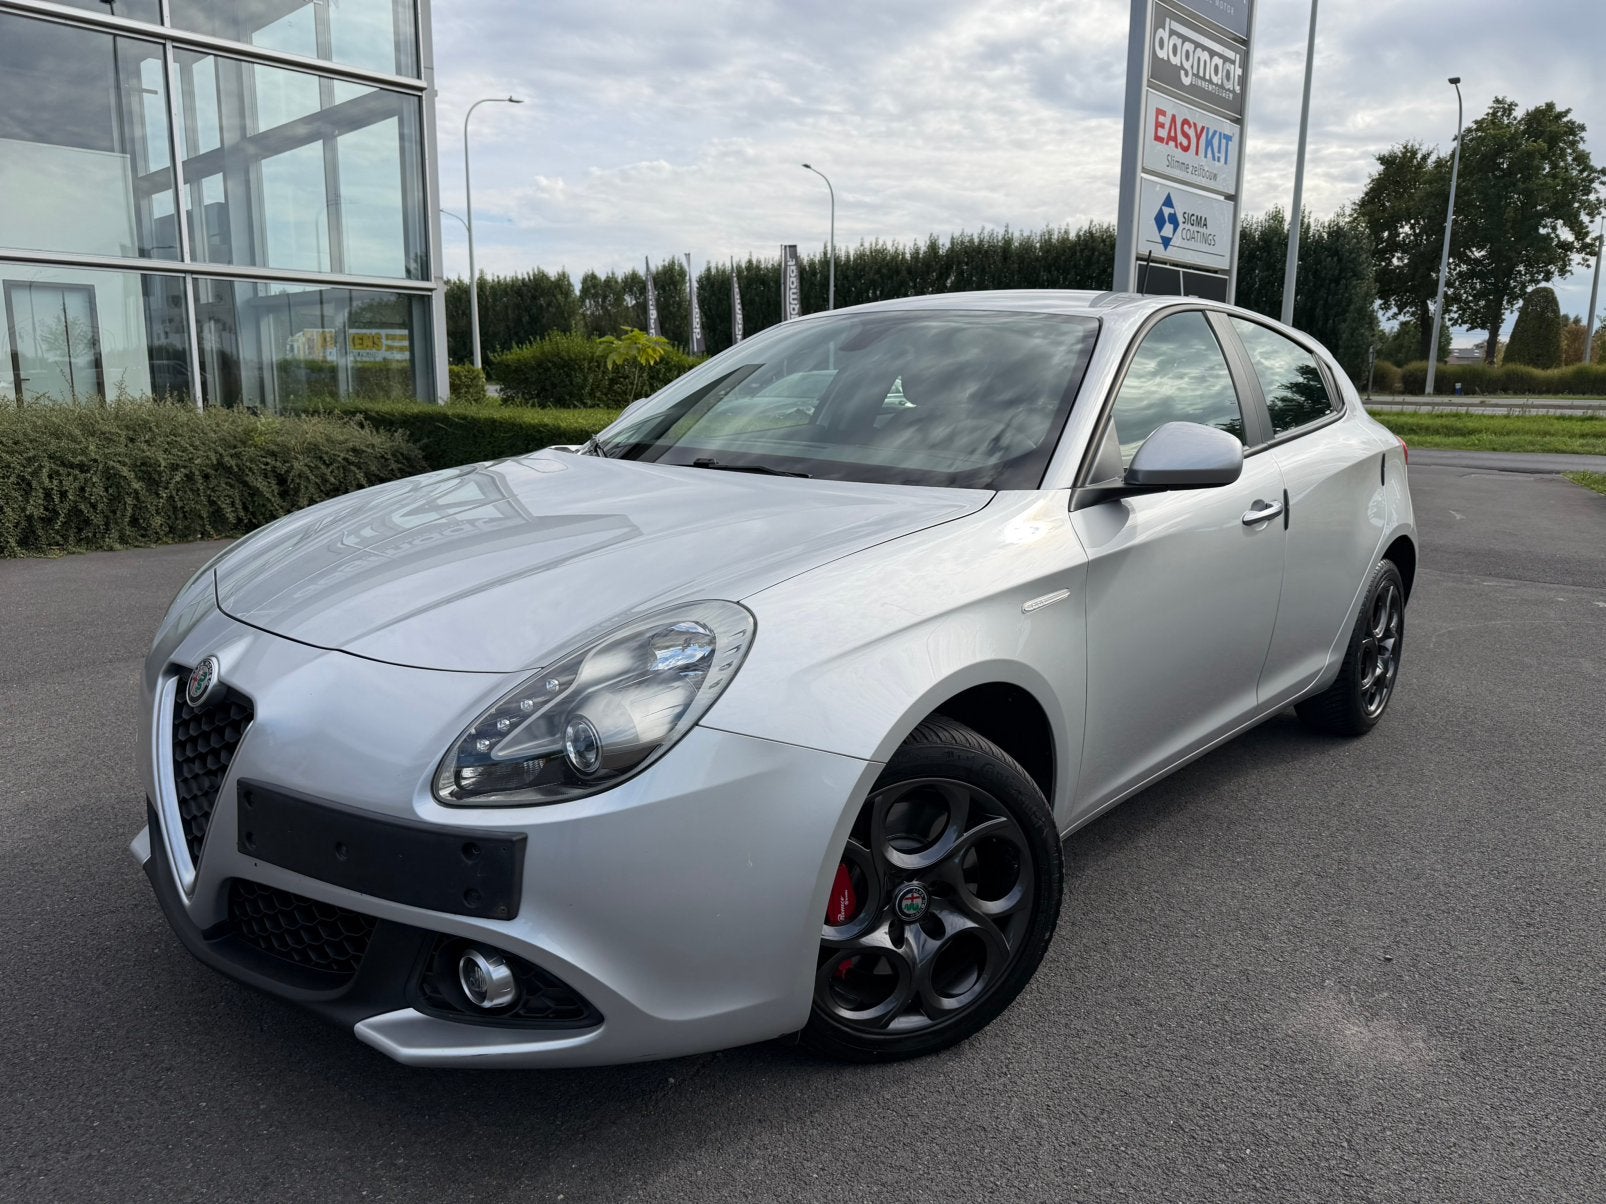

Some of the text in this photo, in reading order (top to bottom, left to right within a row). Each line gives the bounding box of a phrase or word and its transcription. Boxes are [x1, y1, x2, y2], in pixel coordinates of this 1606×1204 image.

[1154, 17, 1242, 94] dagmaat
[1166, 154, 1190, 173] Slimme
[1182, 211, 1208, 230] SIGMA
[1181, 227, 1217, 247] COATINGS
